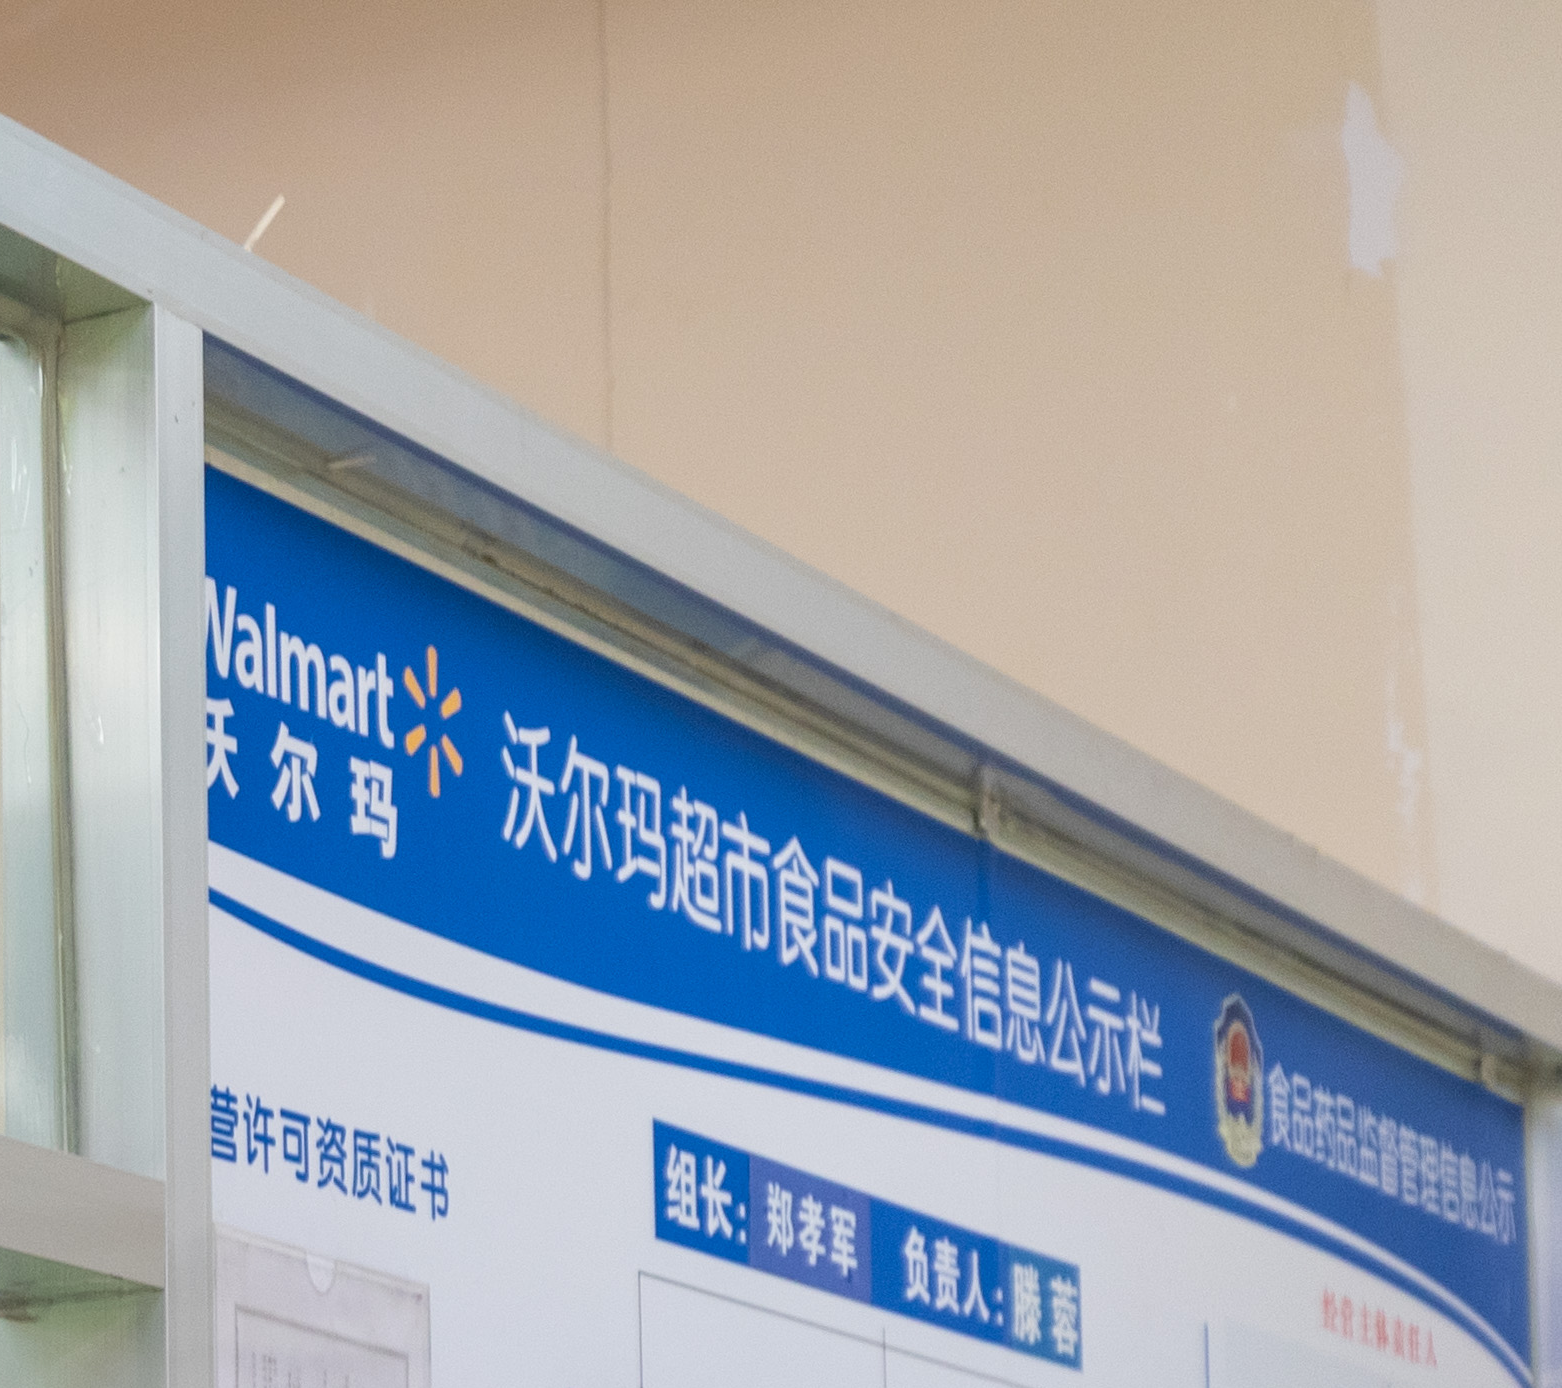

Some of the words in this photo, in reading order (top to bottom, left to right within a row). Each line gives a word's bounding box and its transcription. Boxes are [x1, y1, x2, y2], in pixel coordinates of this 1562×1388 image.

[206, 576, 395, 749] Walmart
[501, 710, 1167, 1116] 沃尔玛超市食品安全信息公示栏
[210, 1084, 451, 1222] 营许可资质证书
